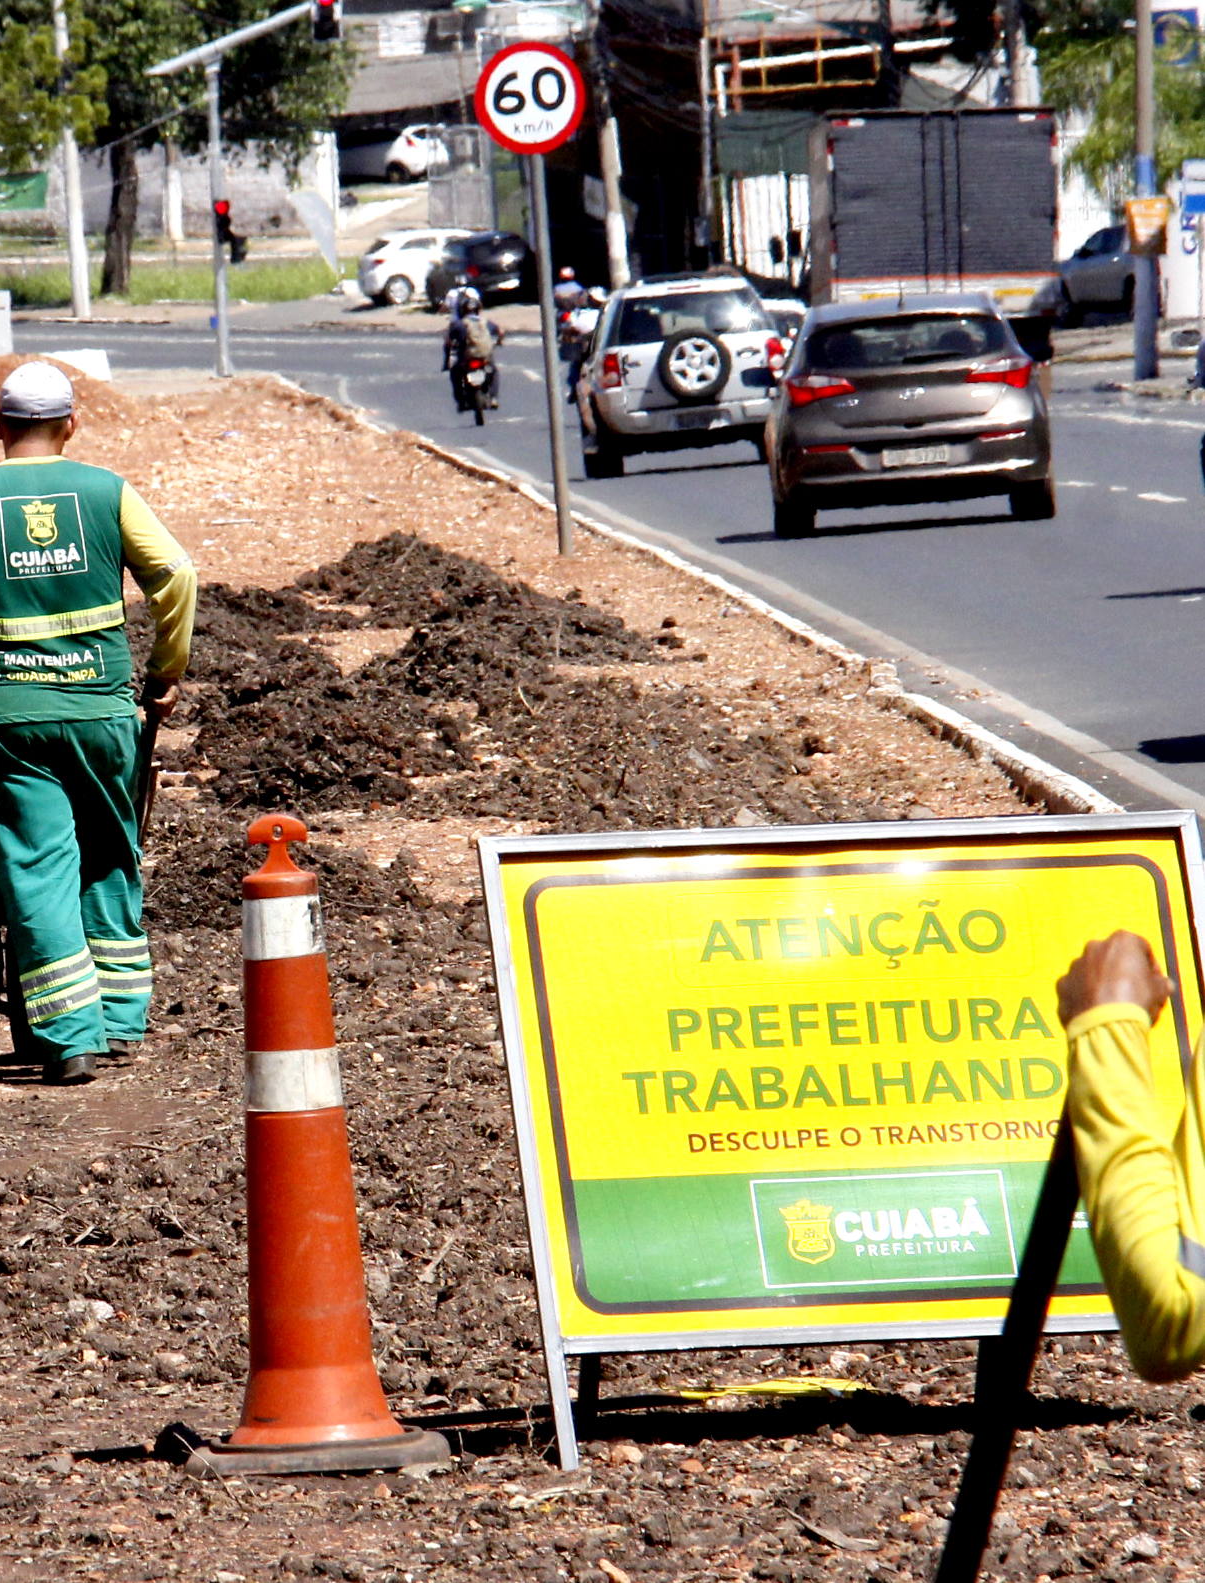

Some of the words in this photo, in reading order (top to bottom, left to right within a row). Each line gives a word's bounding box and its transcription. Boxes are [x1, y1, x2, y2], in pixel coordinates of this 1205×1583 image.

[493, 66, 566, 115] 60
[514, 119, 553, 133] km/h
[9, 542, 81, 568] CUIABÁ
[4, 652, 82, 667] MANTENHA
[83, 649, 95, 663] A
[60, 667, 97, 682] LIMPA
[700, 899, 1007, 970] ATENÇÃO
[667, 996, 1055, 1052] PREFEITURA
[621, 1057, 1063, 1115] TRABALHAND
[688, 1128, 831, 1153] DESCULPE
[839, 1126, 862, 1147] O
[834, 1197, 991, 1243] CUIABÁ
[855, 1239, 976, 1257] PREFEITURA
